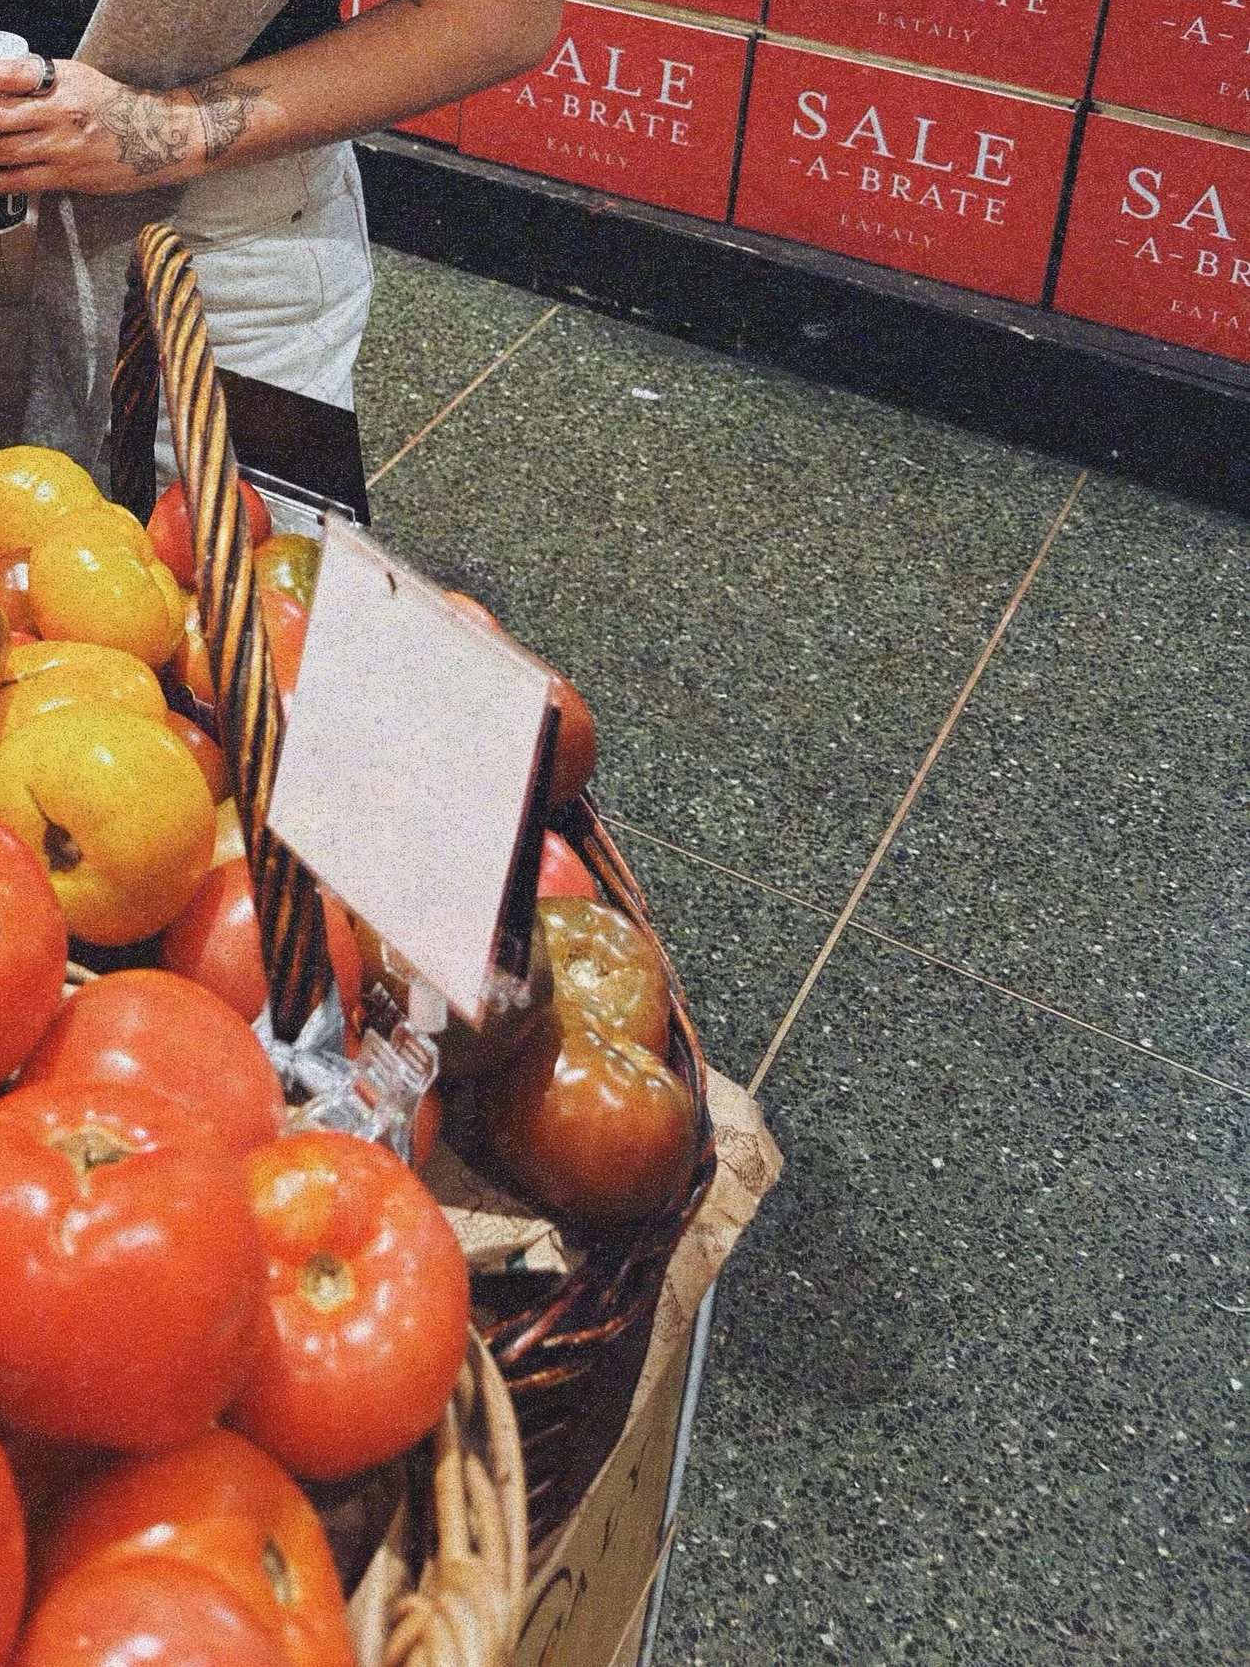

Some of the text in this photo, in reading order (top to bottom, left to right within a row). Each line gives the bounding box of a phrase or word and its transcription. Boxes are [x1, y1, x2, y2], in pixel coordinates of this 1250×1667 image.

[877, 10, 977, 44] EATALY
[1161, 16, 1250, 55] -A-
[544, 36, 697, 110] ALE
[500, 84, 693, 147] -A-BRATE
[792, 90, 1015, 187] SALE
[546, 136, 635, 170] EATALY
[788, 155, 1007, 226] -A-BRATE
[1121, 166, 1237, 242] SA
[839, 213, 938, 250] EATALY
[1170, 299, 1250, 333] EATA
